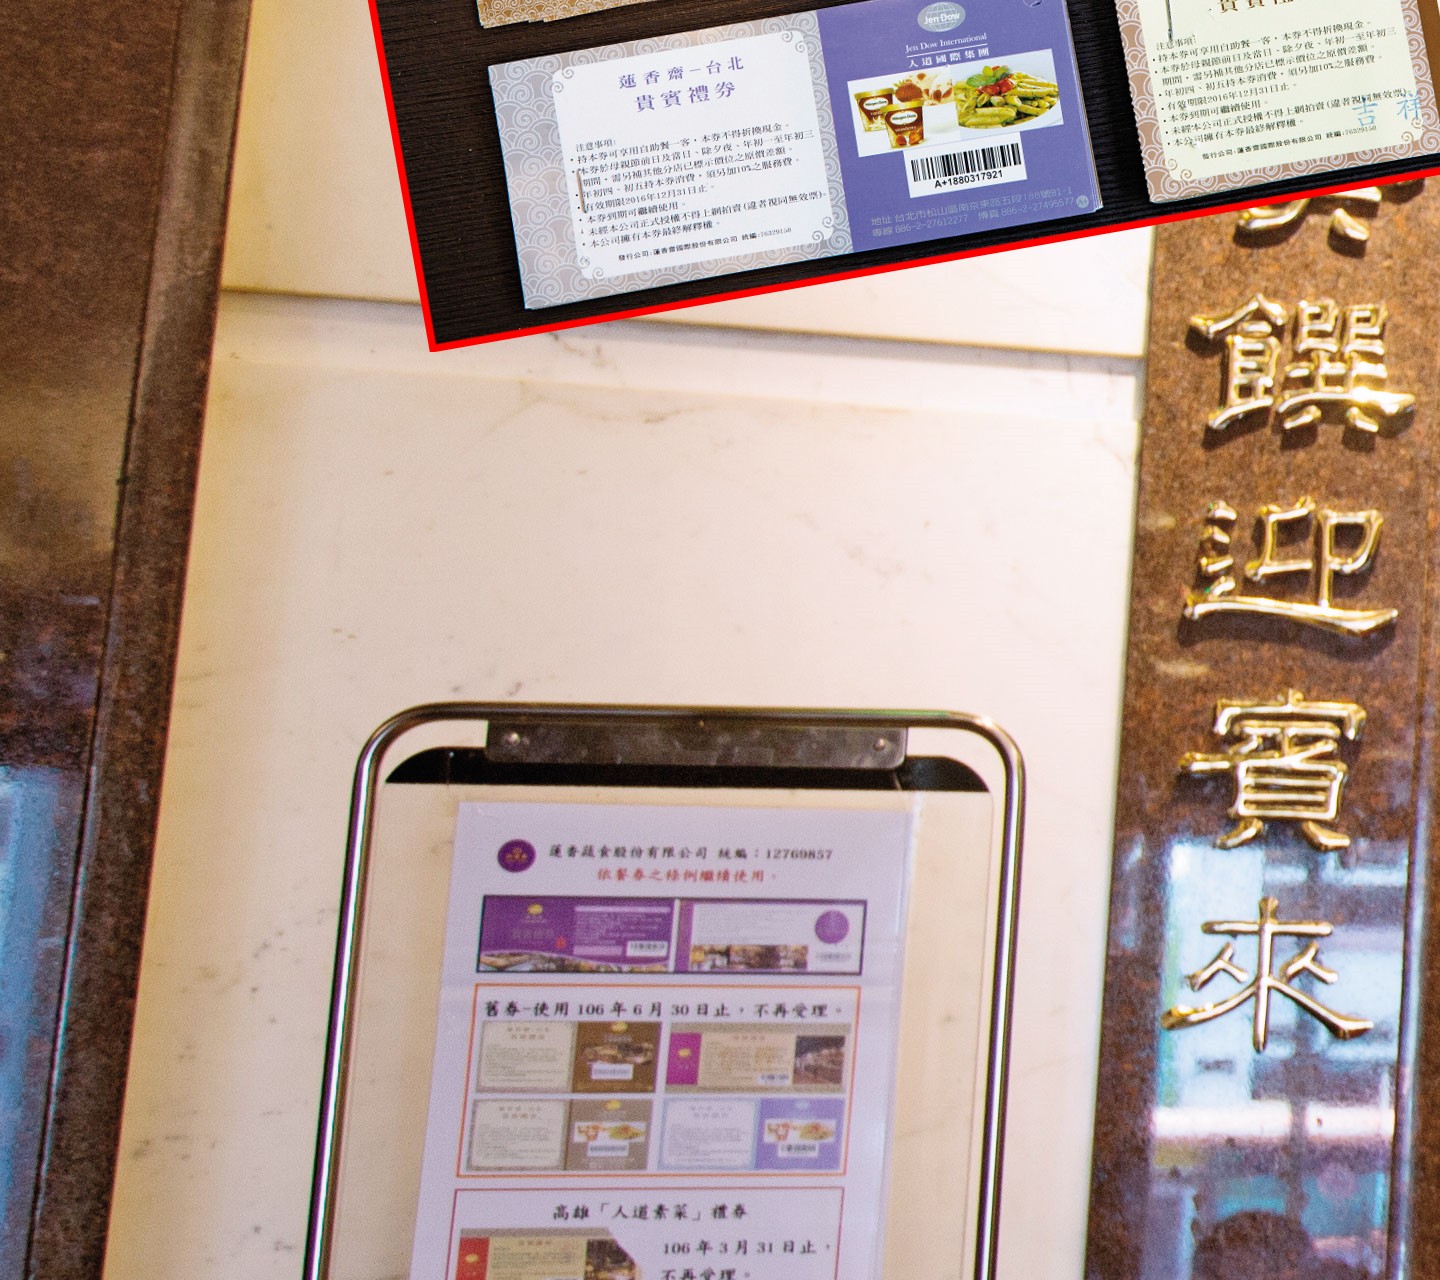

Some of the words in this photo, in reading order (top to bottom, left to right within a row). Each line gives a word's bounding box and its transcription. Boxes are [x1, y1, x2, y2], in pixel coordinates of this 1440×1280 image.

[922, 13, 940, 25] Jen
[939, 10, 961, 22] Dow
[903, 42, 919, 54] Jen
[918, 40, 938, 49] Dow
[939, 31, 987, 46] International
[907, 47, 990, 69] 人道國際集團
[633, 80, 737, 112] 貴賓禮券
[1349, 87, 1424, 129] 吉祥
[933, 169, 1004, 189] A+1880317921
[870, 214, 892, 226] 地址
[1160, 178, 1424, 1052] 饌迎賓來
[577, 1003, 605, 1017] 106
[610, 1001, 627, 1017] 年
[633, 1003, 642, 1017] 6
[649, 1001, 663, 1017] 月
[671, 1003, 690, 1017] 30
[663, 1240, 691, 1255] 106
[696, 1239, 714, 1255] 年
[718, 1240, 729, 1255] 3
[734, 1239, 748, 1256] 月
[756, 1239, 775, 1255] 31
